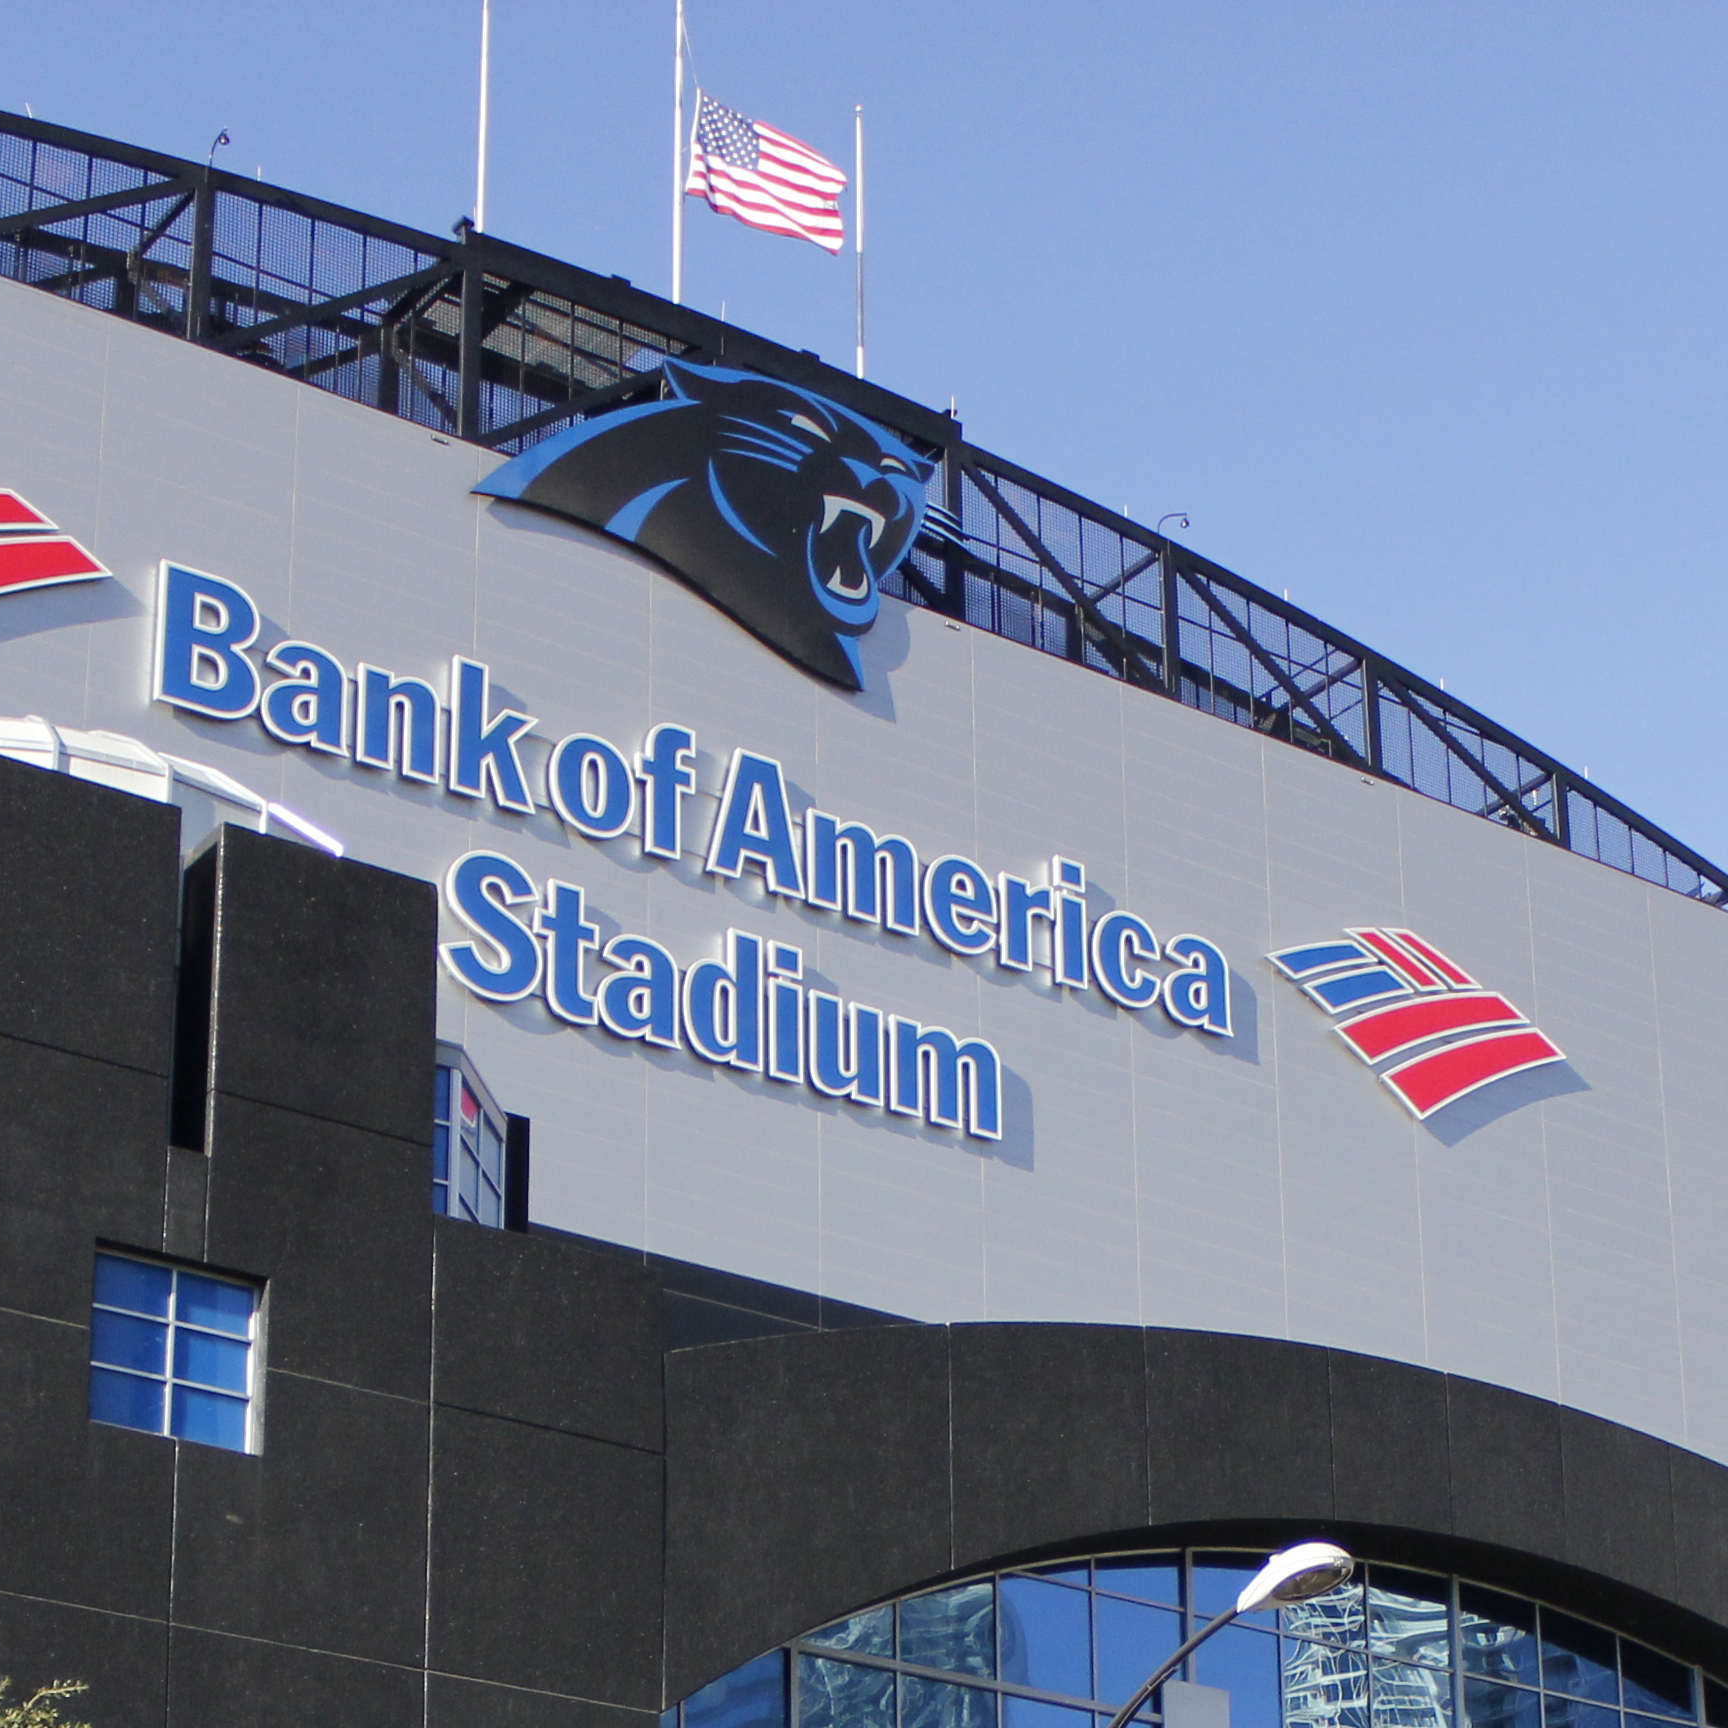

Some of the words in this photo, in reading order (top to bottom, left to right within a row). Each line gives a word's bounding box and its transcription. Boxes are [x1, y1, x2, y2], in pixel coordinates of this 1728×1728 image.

[153, 560, 538, 813] Bank
[547, 722, 697, 859] of
[706, 746, 1235, 1038] America
[438, 850, 1003, 1140] Stadium
